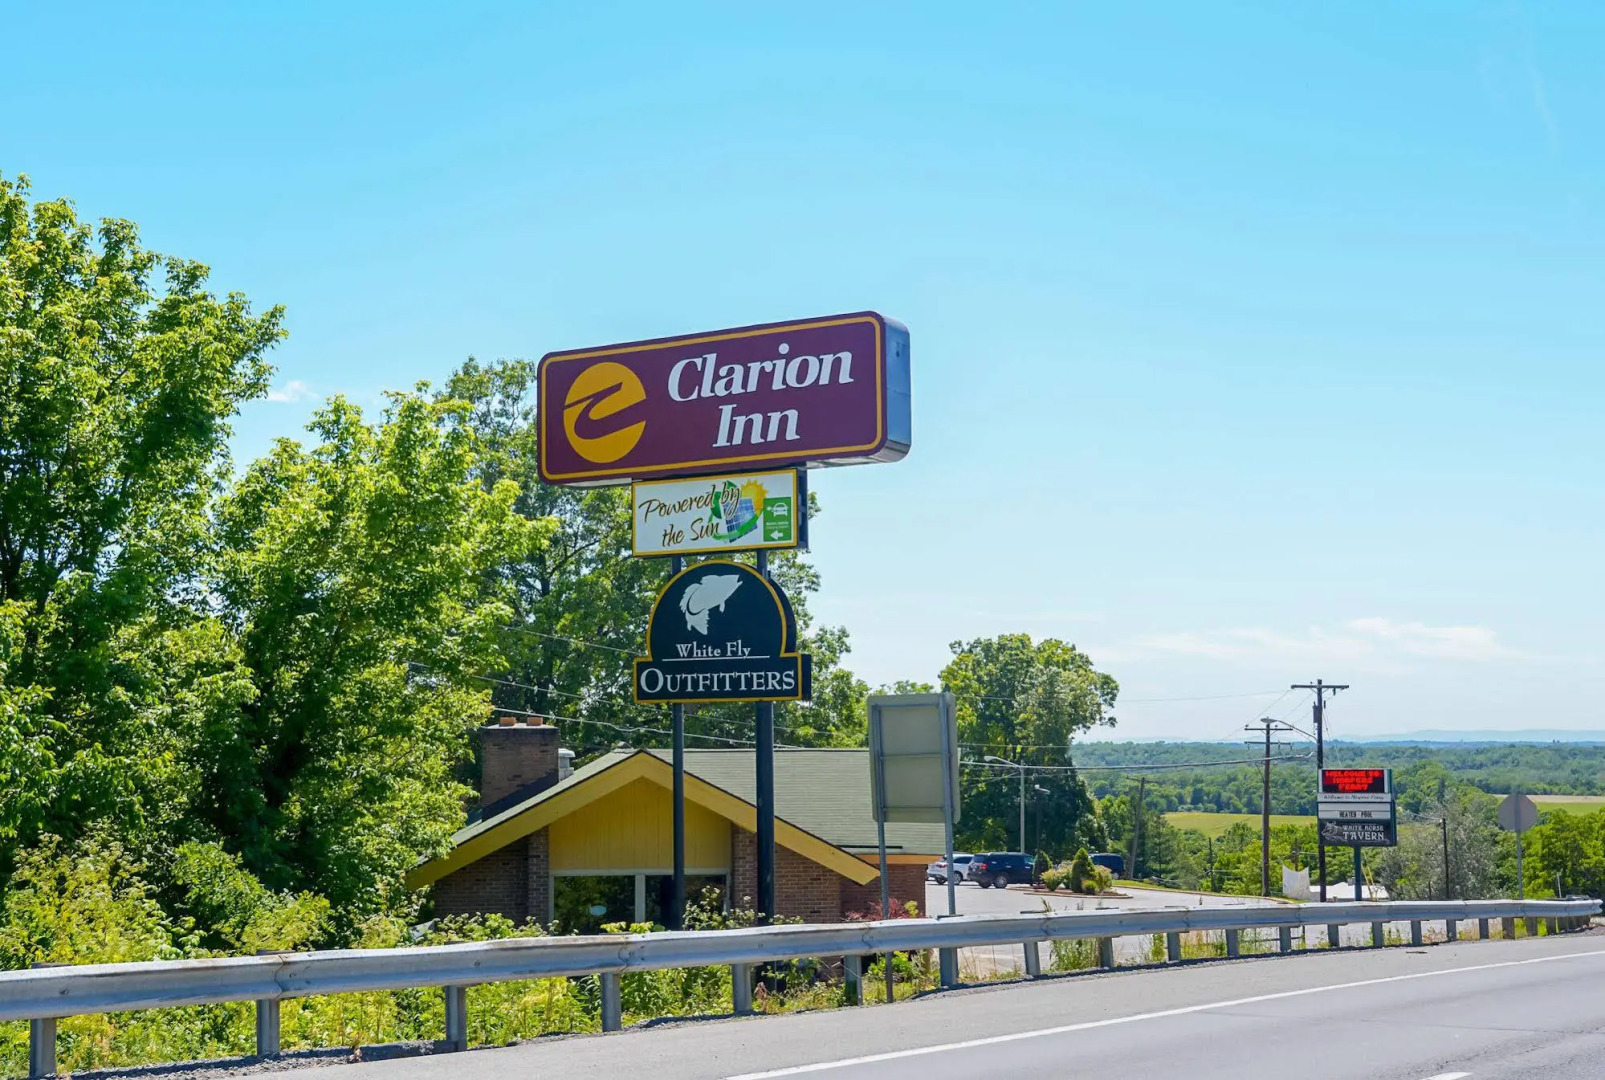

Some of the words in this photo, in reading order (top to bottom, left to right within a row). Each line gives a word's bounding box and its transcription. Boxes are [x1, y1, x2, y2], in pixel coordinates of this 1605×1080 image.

[667, 343, 854, 402] Clarion
[712, 404, 800, 447] Inn
[639, 484, 716, 523] Powered
[720, 481, 740, 518] by
[662, 523, 685, 547] the
[690, 517, 720, 541] Sun
[676, 641, 721, 658] White
[726, 639, 751, 659] Fly
[640, 668, 795, 693] OUTFITTERS
[1342, 831, 1385, 840] TAVERN
